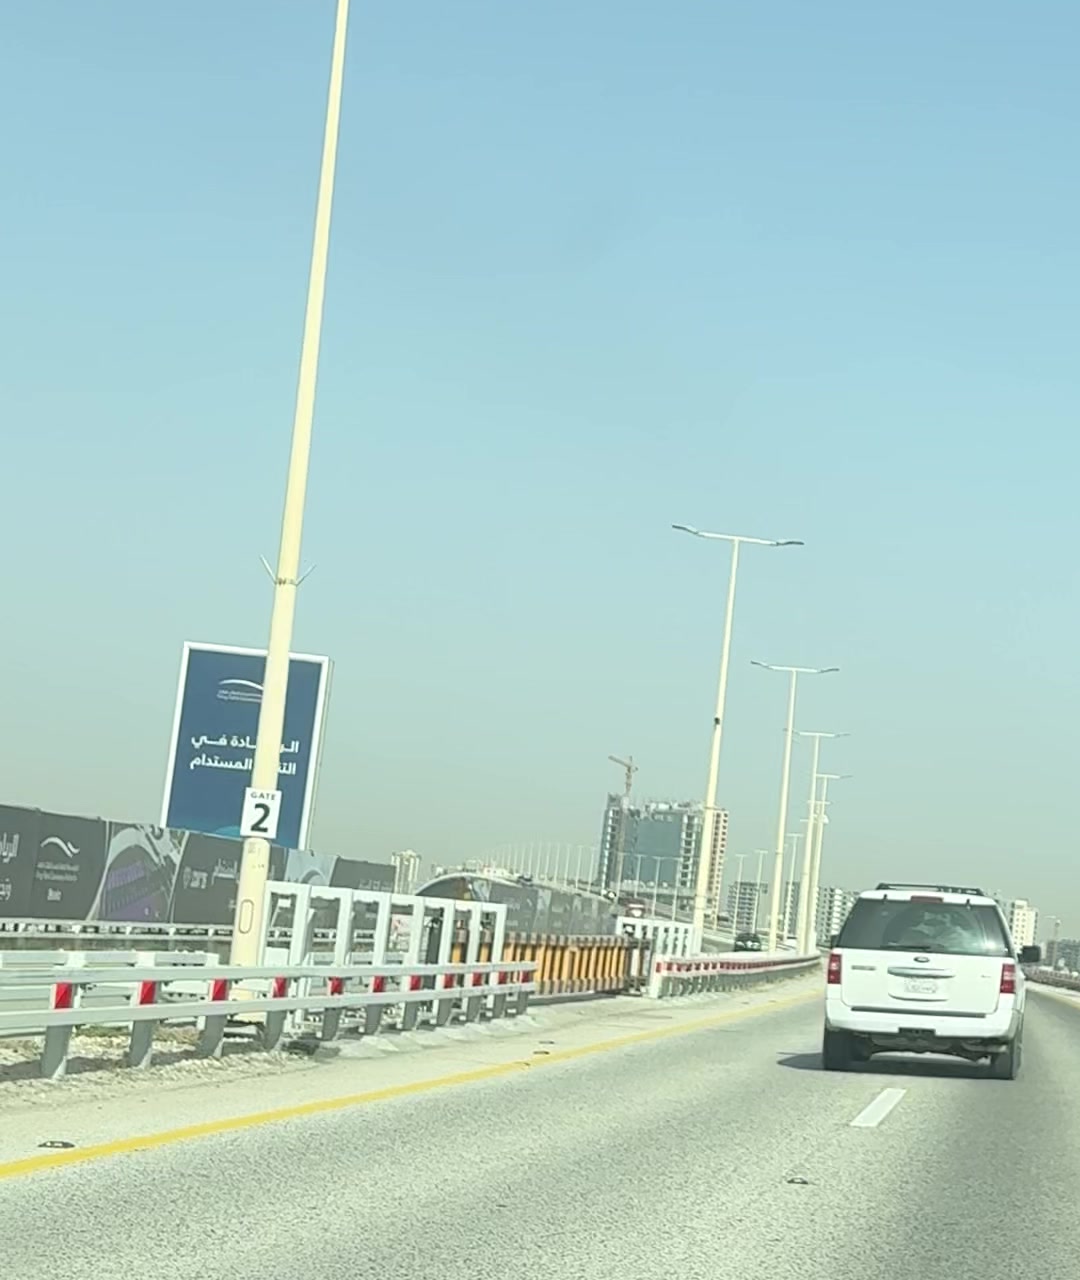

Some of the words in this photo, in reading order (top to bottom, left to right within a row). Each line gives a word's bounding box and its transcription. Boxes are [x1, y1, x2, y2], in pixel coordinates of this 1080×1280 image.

[191, 733, 228, 749] في
[190, 753, 253, 771] المستدام
[250, 791, 276, 801] GATE
[250, 803, 270, 833] 2
